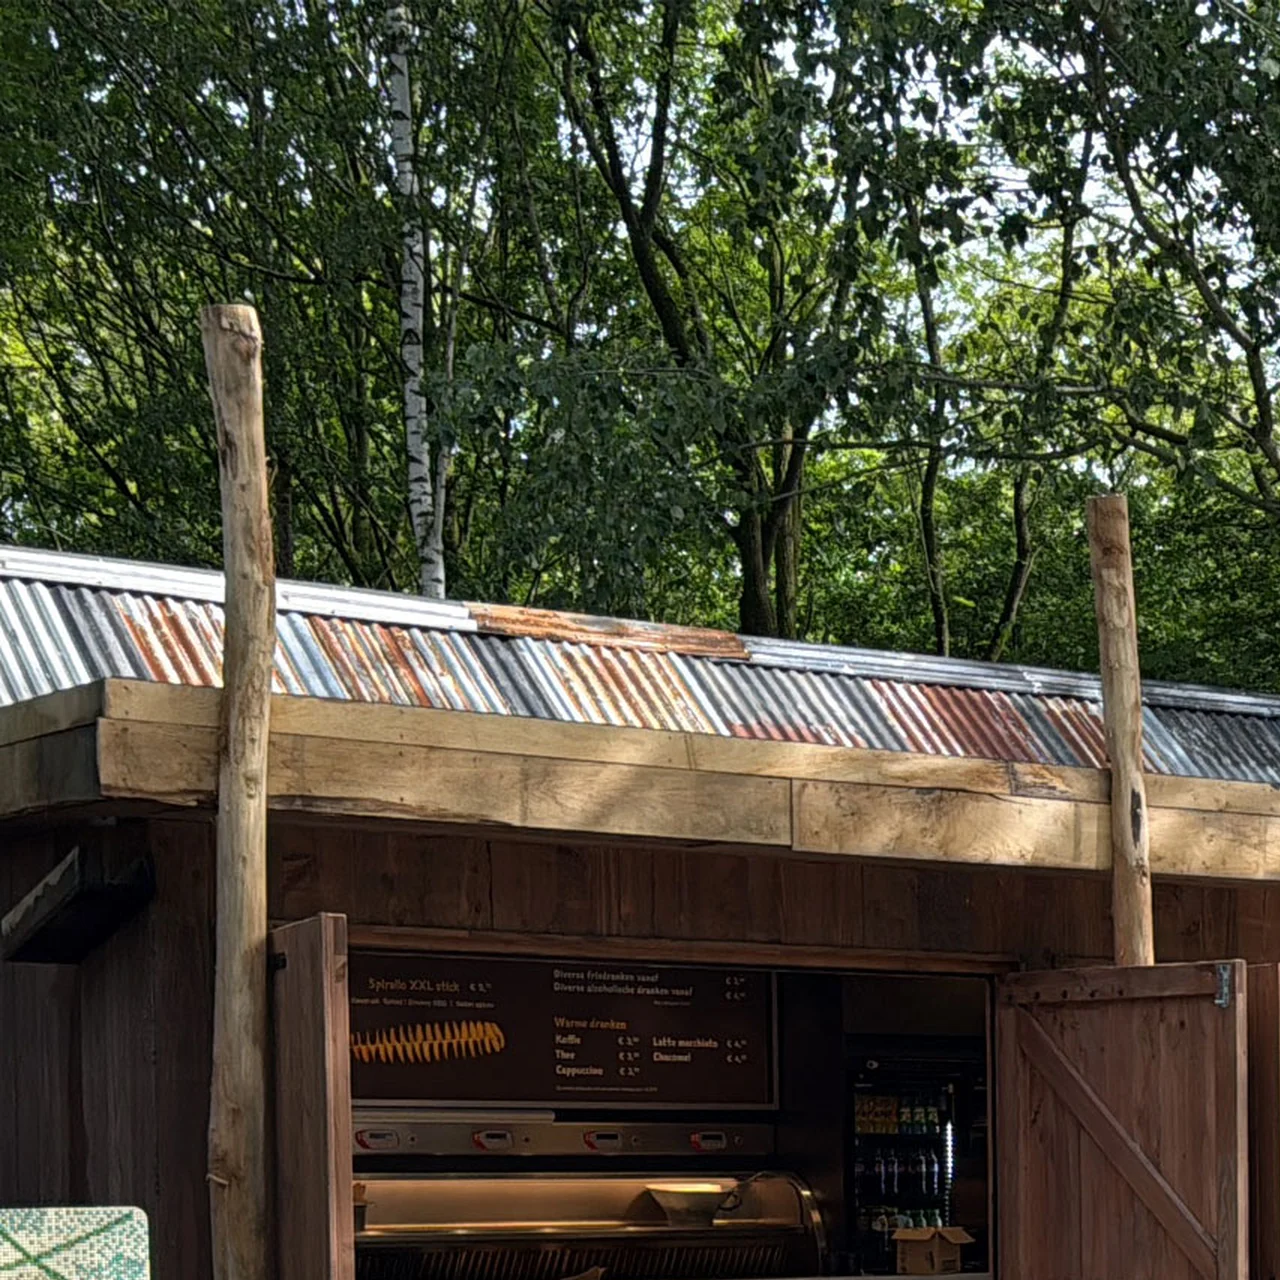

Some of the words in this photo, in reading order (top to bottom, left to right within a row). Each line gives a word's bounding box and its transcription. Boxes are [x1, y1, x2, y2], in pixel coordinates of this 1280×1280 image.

[553, 969, 584, 979] Diverse
[409, 979, 434, 991] XXL
[435, 981, 460, 993] stick
[553, 982, 584, 993] Diverse
[555, 1034, 581, 1045] Koffie
[652, 1037, 676, 1048] Latte
[555, 1065, 603, 1078] Cappuccino
